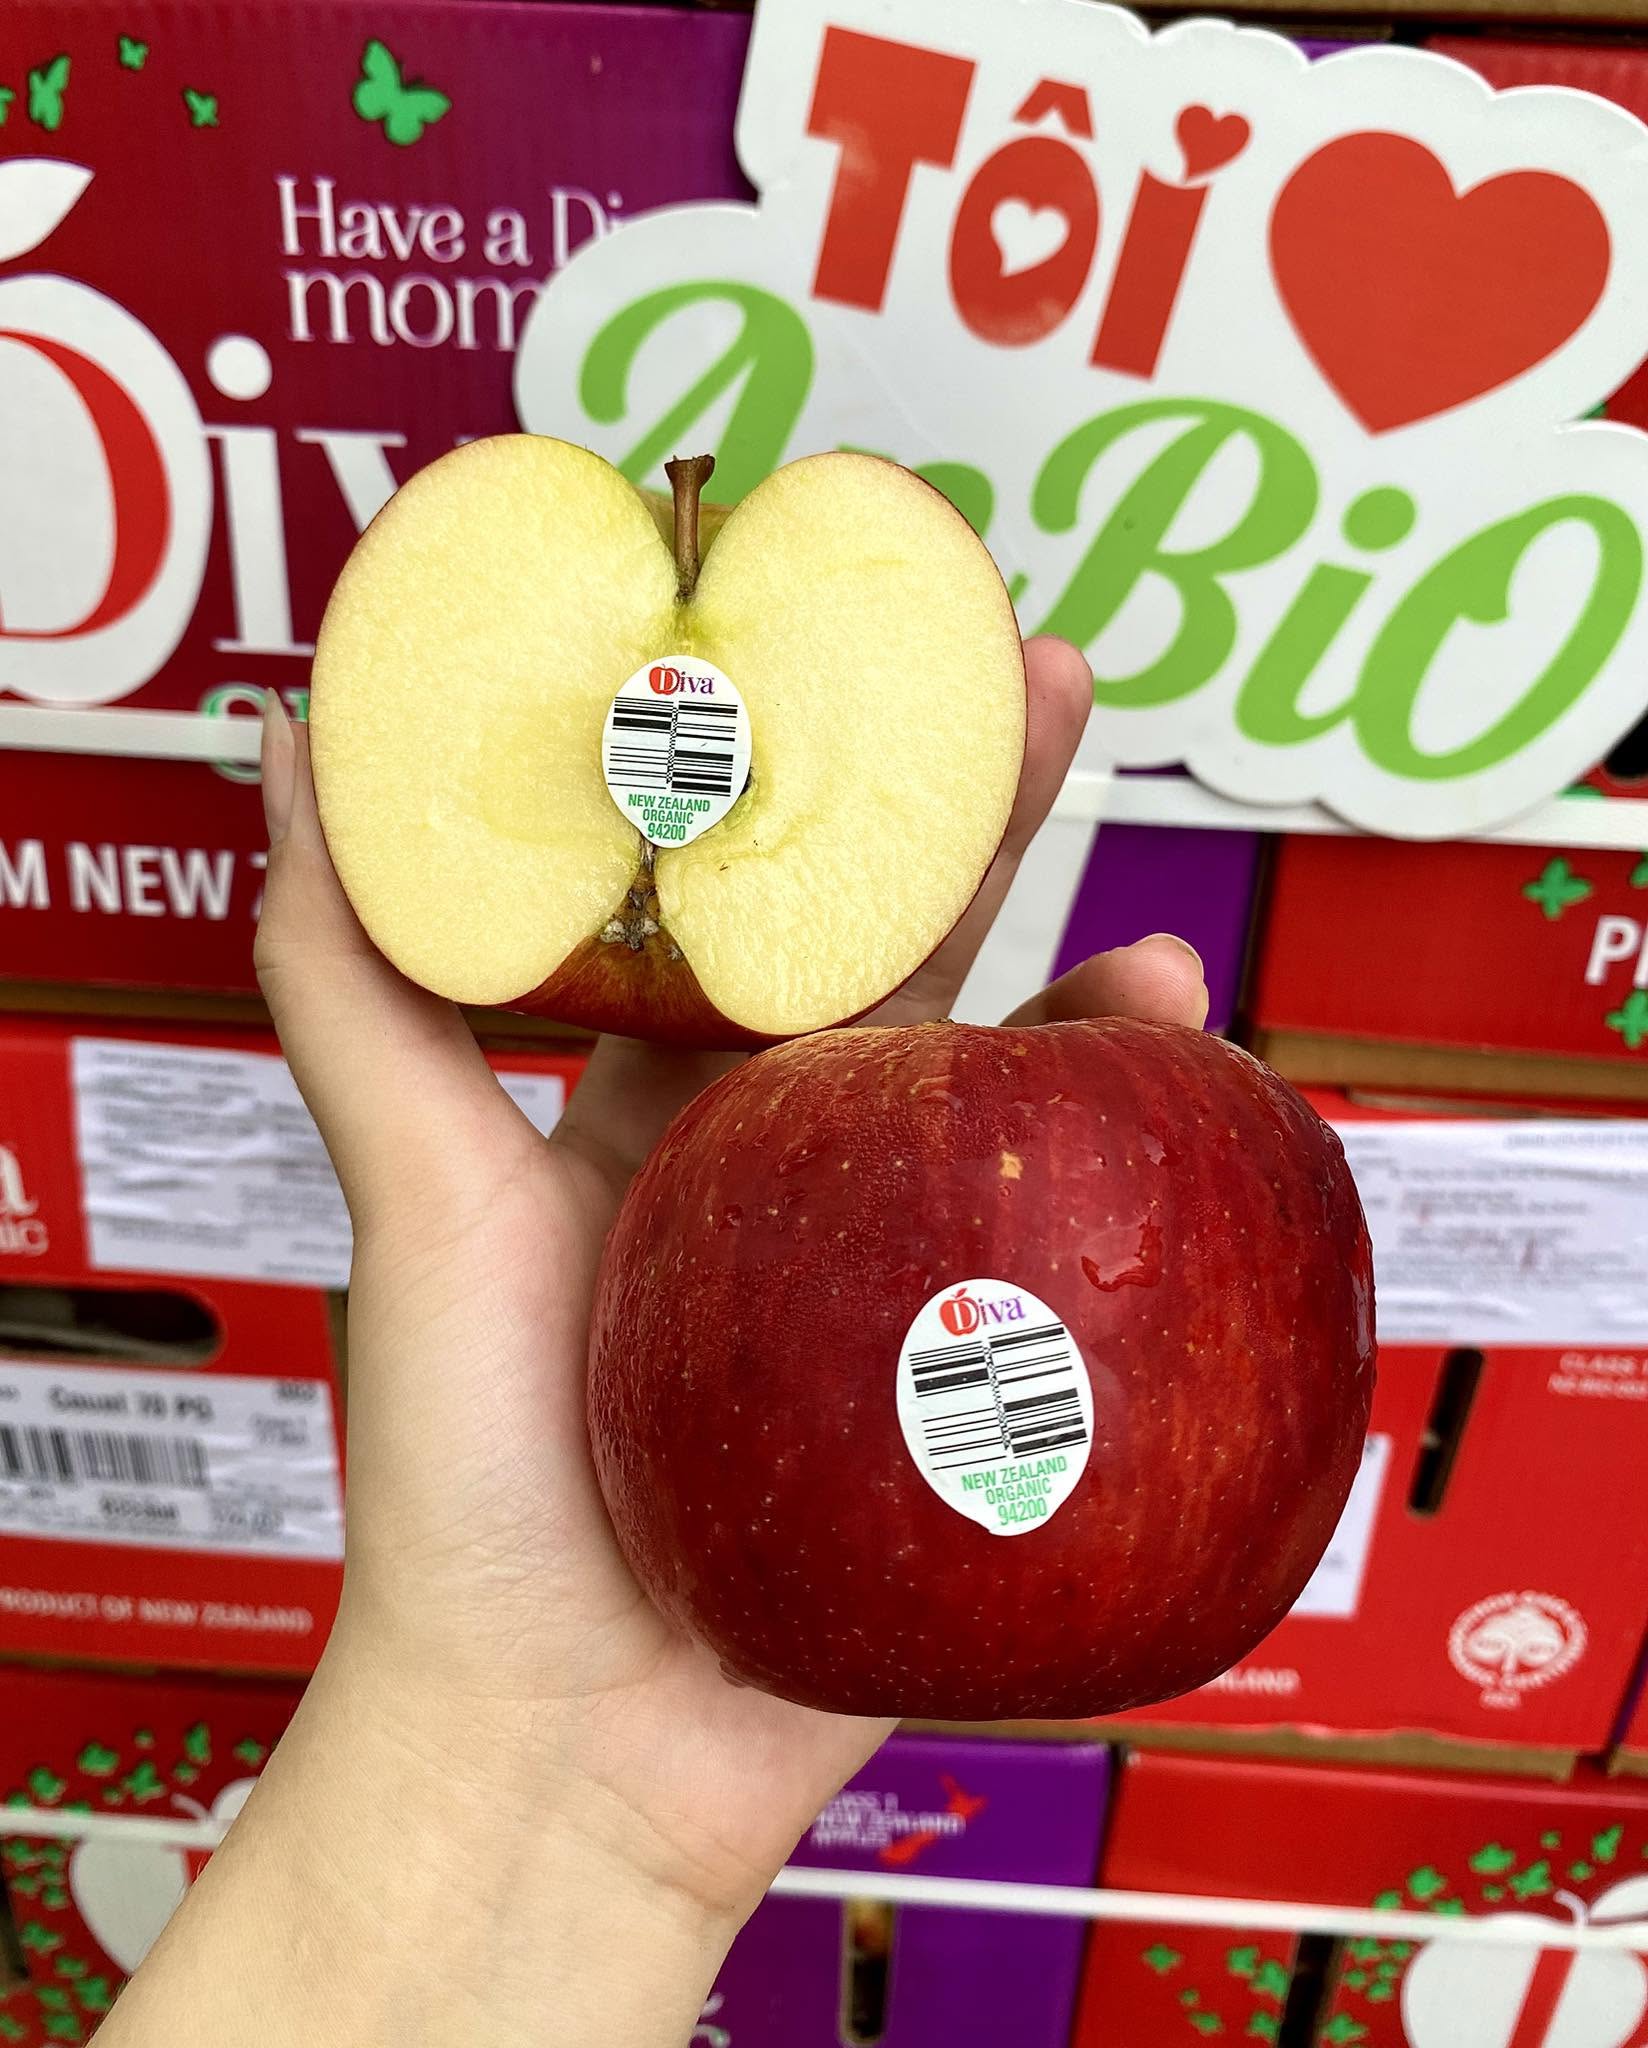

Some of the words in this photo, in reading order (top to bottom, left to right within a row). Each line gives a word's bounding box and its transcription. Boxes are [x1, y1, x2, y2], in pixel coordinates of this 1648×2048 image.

[275, 175, 466, 263] Have
[483, 206, 533, 267] a
[579, 280, 1644, 780] ABiO
[649, 665, 714, 695] Diva
[628, 794, 656, 808] NEW
[657, 796, 710, 812] ZEALAND
[642, 809, 694, 825] ORGANIC
[647, 822, 686, 841] 94200
[66, 841, 235, 921] NEW
[939, 1293, 1026, 1336] Diva
[961, 1470, 999, 1491] NEW
[1000, 1456, 1068, 1485] ZEALAND
[985, 1477, 1052, 1505] ORGANIC
[998, 1498, 1048, 1526] 94200
[138, 1597, 198, 1628] NEW
